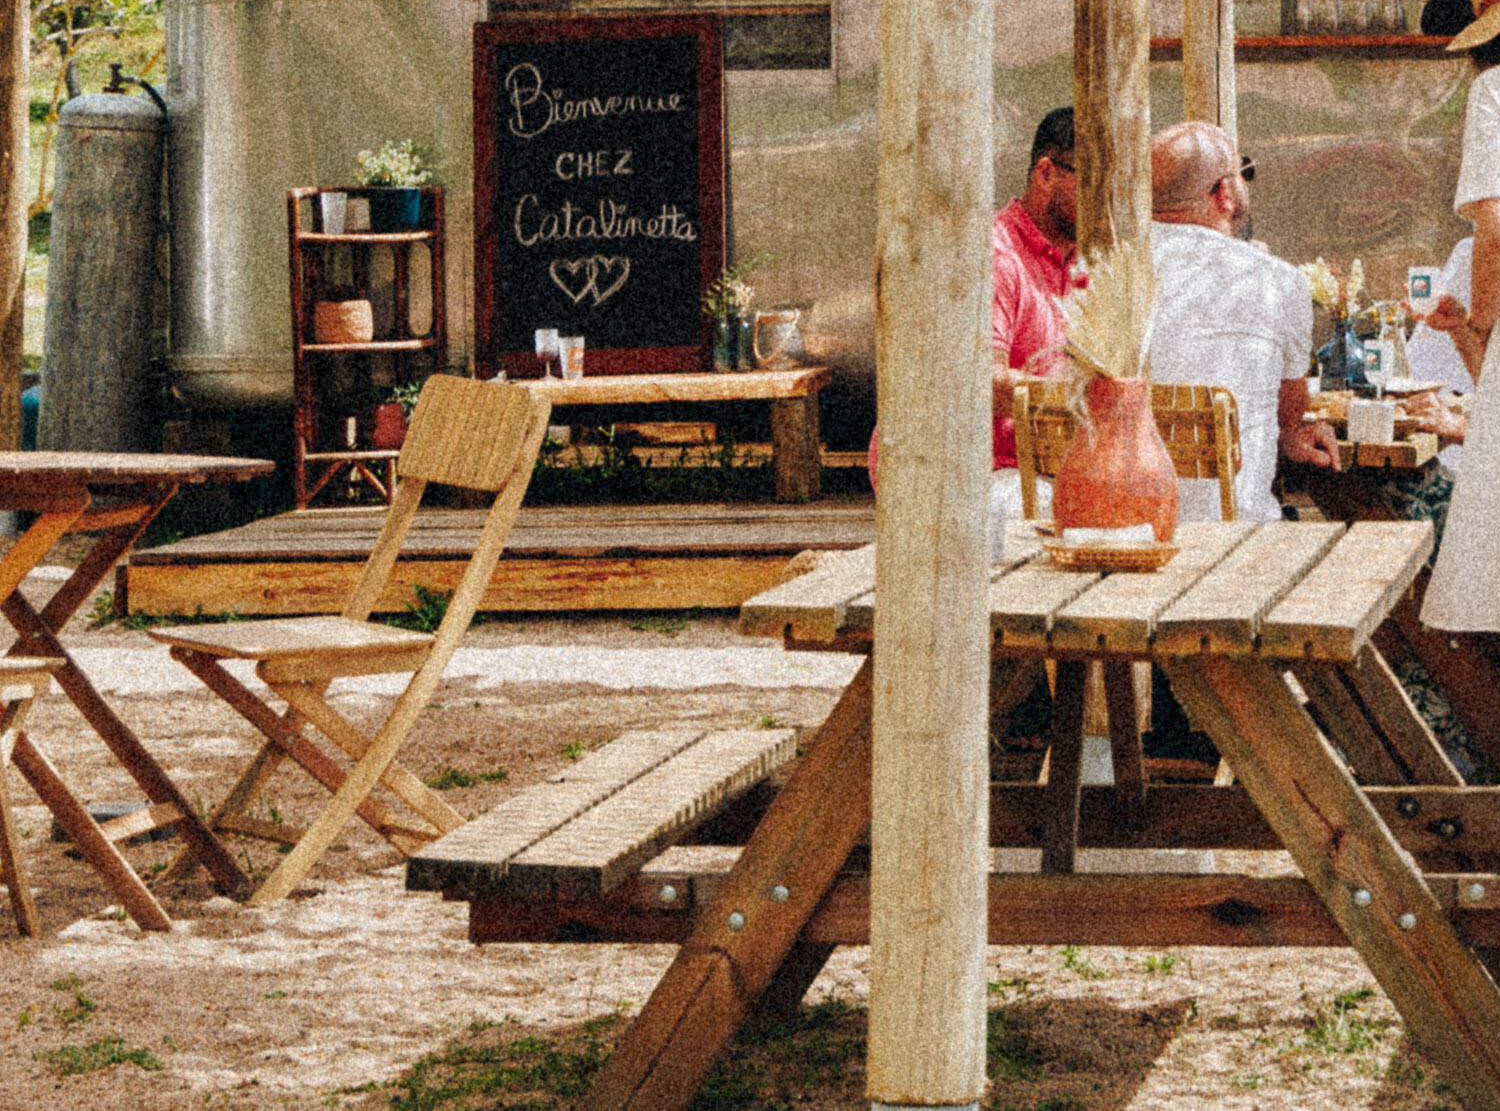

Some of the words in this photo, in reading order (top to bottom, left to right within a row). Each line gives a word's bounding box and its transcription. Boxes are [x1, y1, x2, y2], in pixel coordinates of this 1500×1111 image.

[505, 62, 685, 137] Bienvenue
[555, 150, 634, 179] CHEZ
[514, 194, 697, 246] Catalinetta
